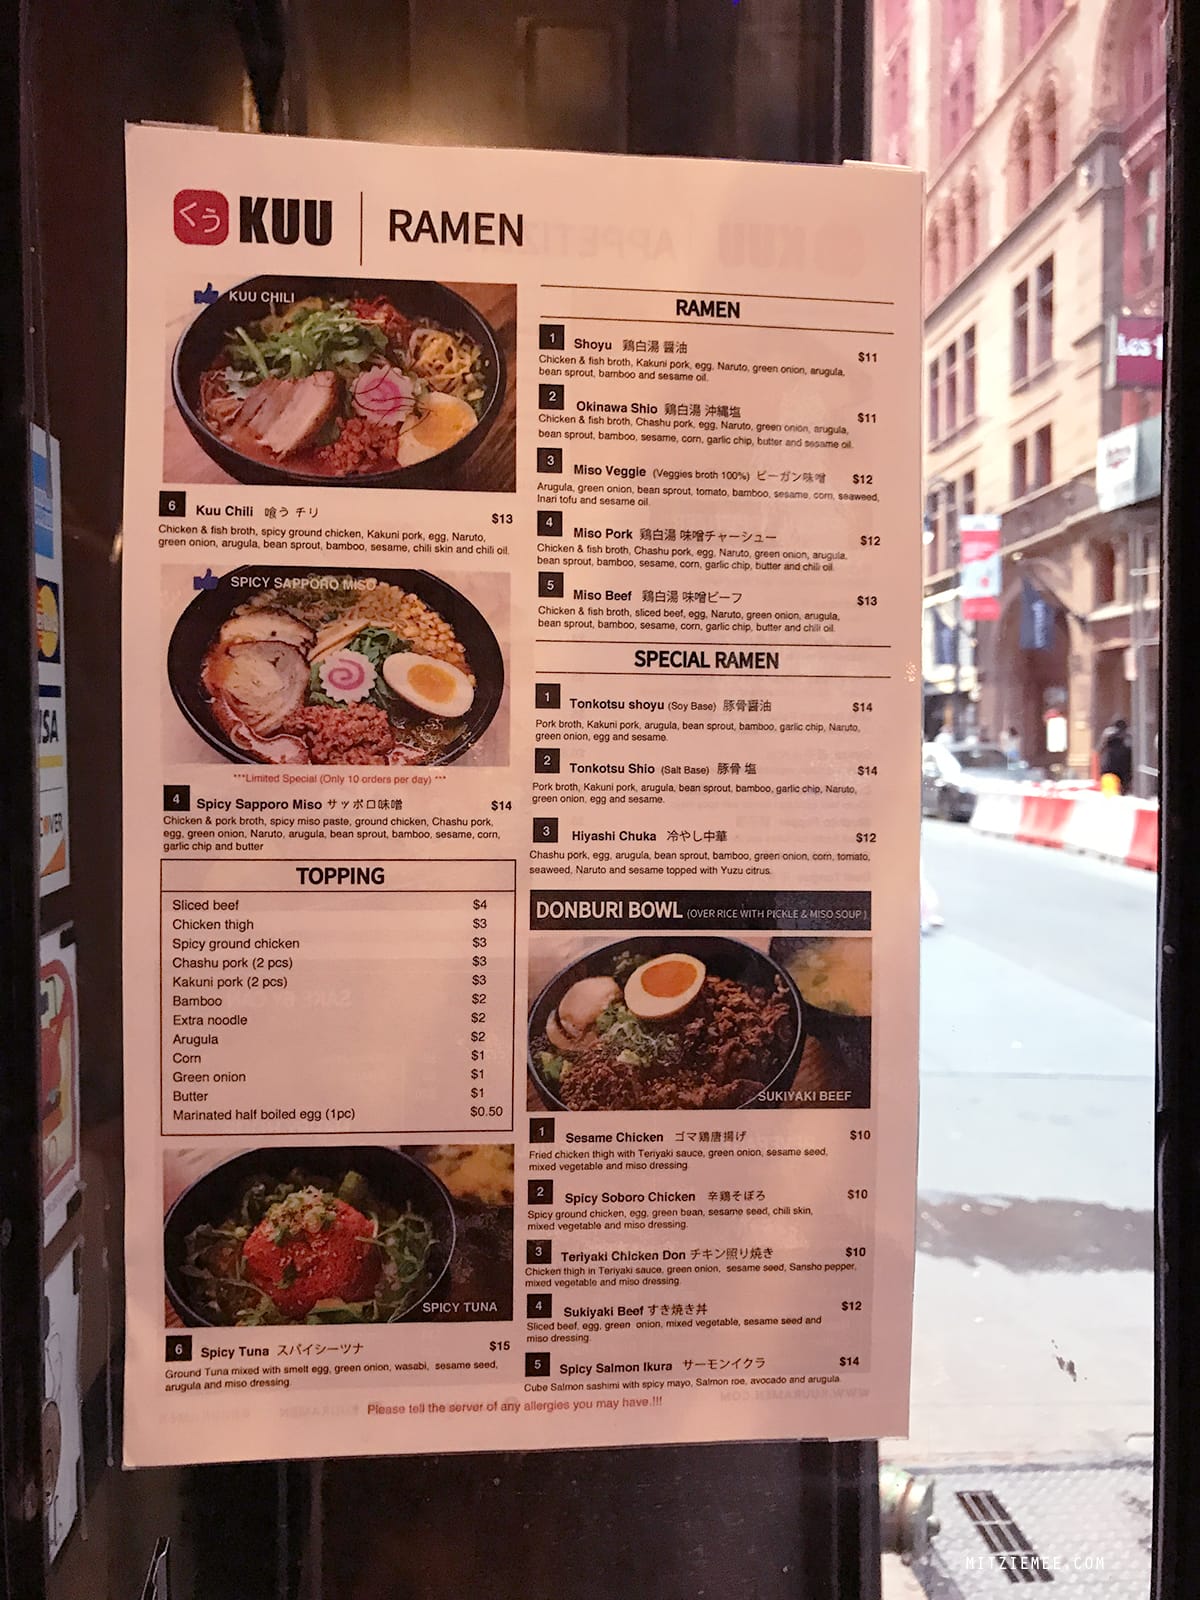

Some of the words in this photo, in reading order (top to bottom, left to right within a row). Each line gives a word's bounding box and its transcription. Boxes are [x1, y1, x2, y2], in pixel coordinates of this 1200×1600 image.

[179, 202, 220, 233] くう
[240, 196, 332, 246] KUU
[389, 209, 524, 247] RAMEN
[227, 288, 257, 303] KUU
[260, 290, 295, 306] CHILI
[675, 298, 741, 320] RAMEN
[573, 337, 613, 353] Shoyu
[857, 351, 877, 363] $11
[575, 400, 628, 414] Okinawa
[630, 402, 658, 415] Shio
[857, 412, 877, 424] $11
[573, 463, 603, 477] Miso
[605, 465, 647, 480] Veggie
[652, 467, 693, 481] (Veggies
[694, 469, 719, 480] broth
[852, 473, 873, 485] $12
[195, 504, 222, 517] Kuu
[224, 504, 254, 518] Chili
[491, 512, 514, 525] $13
[573, 527, 603, 540] Miso
[605, 527, 634, 540] Pork
[860, 535, 881, 547] $12
[231, 575, 269, 589] SPICY
[273, 576, 339, 590] SAPPORO
[343, 578, 376, 591] MISO
[573, 588, 602, 601] Miso
[604, 589, 633, 602] Beef
[856, 594, 878, 607] $13
[633, 649, 711, 669] SPECIAL
[714, 650, 780, 670] RAMEN
[568, 697, 626, 710] Tonkotsu
[628, 698, 665, 713] shoyu
[852, 701, 873, 713] $14
[569, 762, 625, 775] Tonkotsu
[628, 762, 656, 775] Shio
[857, 765, 878, 777] $14
[196, 797, 232, 813] Spicy
[234, 798, 289, 813] Sapporo
[292, 798, 323, 811] Miso
[490, 799, 513, 812] $14
[571, 830, 616, 844] Hiyashi
[618, 830, 657, 842] Chuka
[855, 832, 877, 844] $12
[162, 840, 190, 854] garlic
[191, 841, 213, 853] chip
[214, 841, 234, 851] and
[235, 841, 265, 852] butter
[295, 866, 385, 886] TOPPING
[575, 863, 607, 875] Naruto
[608, 864, 627, 875] and
[627, 864, 665, 875] sesame
[665, 865, 698, 877] topped
[699, 865, 719, 875] with
[720, 865, 744, 876] Yuzu
[172, 898, 210, 912] Sliced
[212, 898, 240, 912] beef
[472, 898, 488, 911] $4
[536, 900, 624, 921] DONBURI
[628, 900, 684, 919] BOWL
[172, 918, 222, 931] Chicken
[224, 918, 255, 934] thigh
[472, 917, 488, 930] $3
[172, 937, 207, 953] Spicy
[208, 937, 252, 953] ground
[254, 937, 300, 950] chicken
[472, 936, 488, 949] $3
[172, 994, 223, 1008] Bamboo
[471, 992, 487, 1006] $2
[172, 1014, 204, 1027] Extra
[207, 1014, 248, 1026] noodle
[470, 1011, 486, 1025] $2
[172, 1033, 219, 1048] Arugula
[470, 1030, 487, 1043] $2
[172, 1090, 209, 1103] Butter
[470, 1086, 484, 1100] $1
[756, 1089, 817, 1104] SUKIYAKI
[818, 1090, 852, 1104] BEEF
[172, 1108, 233, 1121] Marinated
[235, 1108, 258, 1121] half
[260, 1108, 297, 1121] boiled
[299, 1110, 322, 1123] egg
[325, 1107, 356, 1121] (1pc)
[565, 1132, 614, 1144] Sesame
[615, 1131, 664, 1143] Chicken
[849, 1129, 871, 1142] $10
[564, 1192, 599, 1208] Spicy
[600, 1191, 646, 1205] Soboro
[647, 1191, 696, 1204] Chicken
[847, 1188, 869, 1200] $10
[560, 1250, 609, 1265] Teriyaki
[610, 1250, 659, 1262] Chicken
[662, 1249, 686, 1261] Don
[845, 1246, 867, 1258] $10
[422, 1301, 461, 1314] SPICY
[463, 1301, 498, 1313] TUNA
[563, 1305, 614, 1320] Sukiyaki
[617, 1305, 645, 1317] Beef
[841, 1300, 863, 1312] $12
[200, 1346, 236, 1361] Spicy
[238, 1345, 270, 1358] Tuna
[488, 1340, 511, 1353] $15
[559, 1363, 593, 1377] Spicy
[595, 1362, 640, 1374] Salmon
[643, 1361, 673, 1375] Ikura
[682, 1357, 766, 1372] サーモンイクラ
[839, 1355, 860, 1368] $14
[367, 1403, 405, 1415] Please
[409, 1403, 425, 1414] tell
[428, 1402, 446, 1413] the
[449, 1404, 483, 1413] server
[486, 1401, 498, 1412] of
[501, 1402, 521, 1415] any
[524, 1400, 570, 1413] allergies
[573, 1401, 593, 1412] you
[596, 1400, 619, 1410] may
